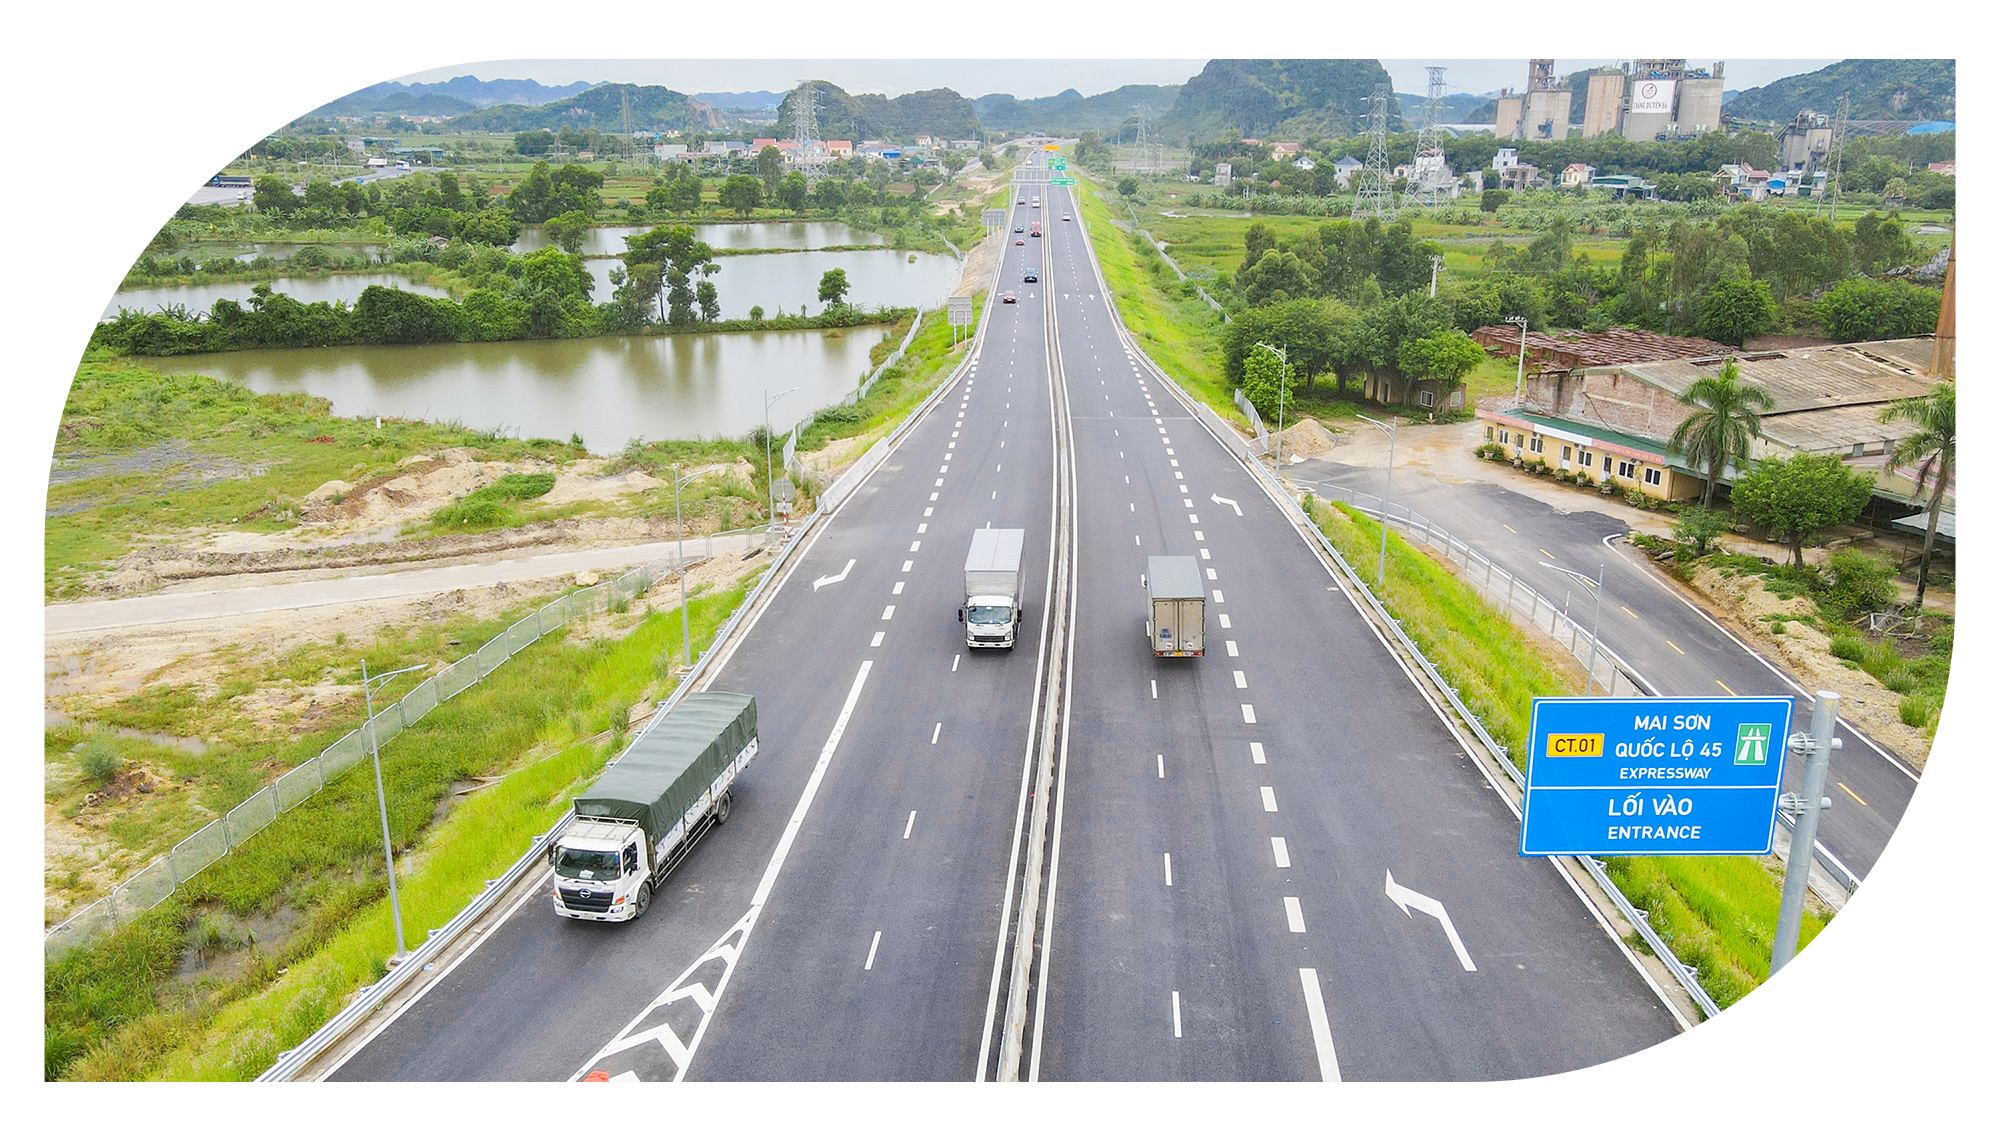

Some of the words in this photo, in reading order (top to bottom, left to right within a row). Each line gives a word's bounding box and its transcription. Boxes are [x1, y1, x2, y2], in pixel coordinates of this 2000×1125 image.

[1634, 715, 1667, 730] MAI
[1673, 713, 1711, 730] SƠN
[1555, 738, 1595, 753] CT.01
[1615, 736, 1665, 757] QUỐC
[1670, 739, 1694, 760] LỘ
[1700, 742, 1722, 757] 45
[1620, 767, 1712, 779] EXPRESSWAY
[1608, 791, 1644, 816] LỐI
[1652, 793, 1693, 816] VÀO
[1608, 825, 1702, 839] ENTRANCE
